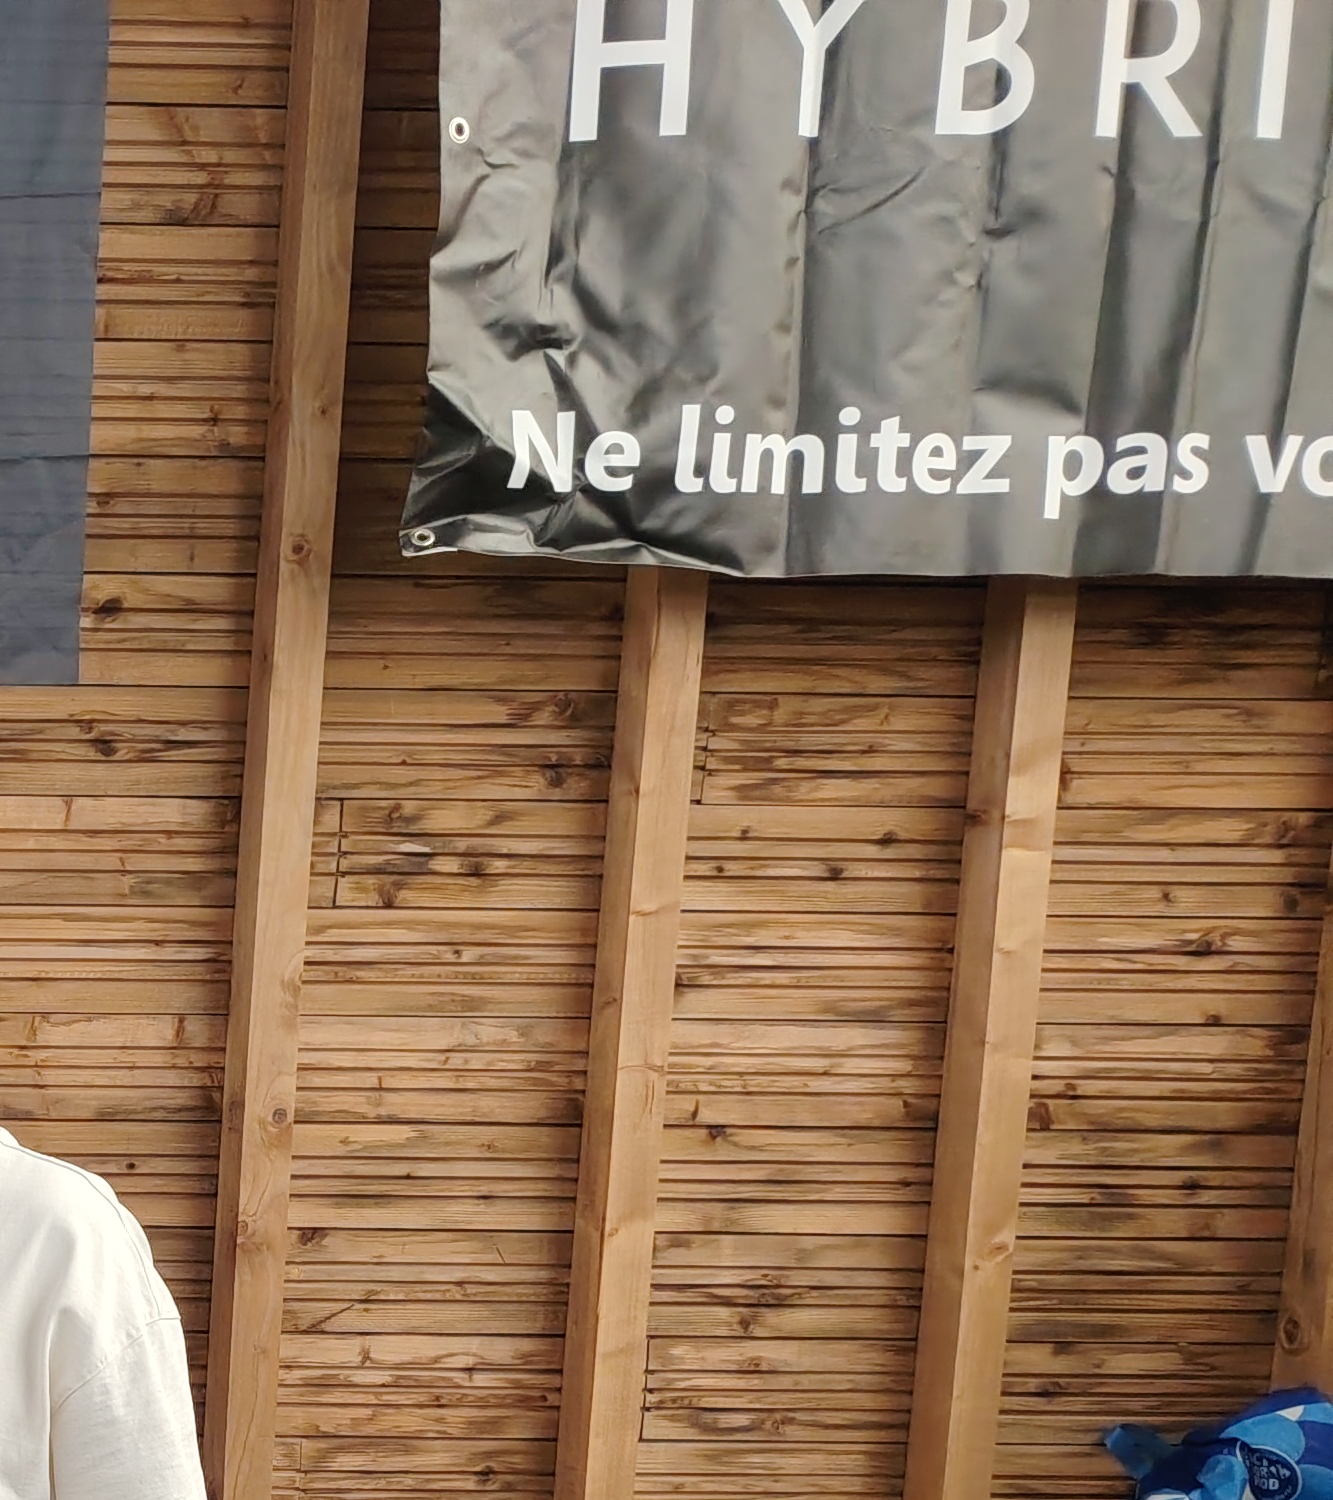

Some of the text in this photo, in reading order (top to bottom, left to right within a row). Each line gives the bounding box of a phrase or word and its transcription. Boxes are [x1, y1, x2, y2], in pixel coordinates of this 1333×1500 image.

[506, 409, 640, 494] Ne
[674, 404, 1011, 496] limitez
[1044, 431, 1210, 520] pas
